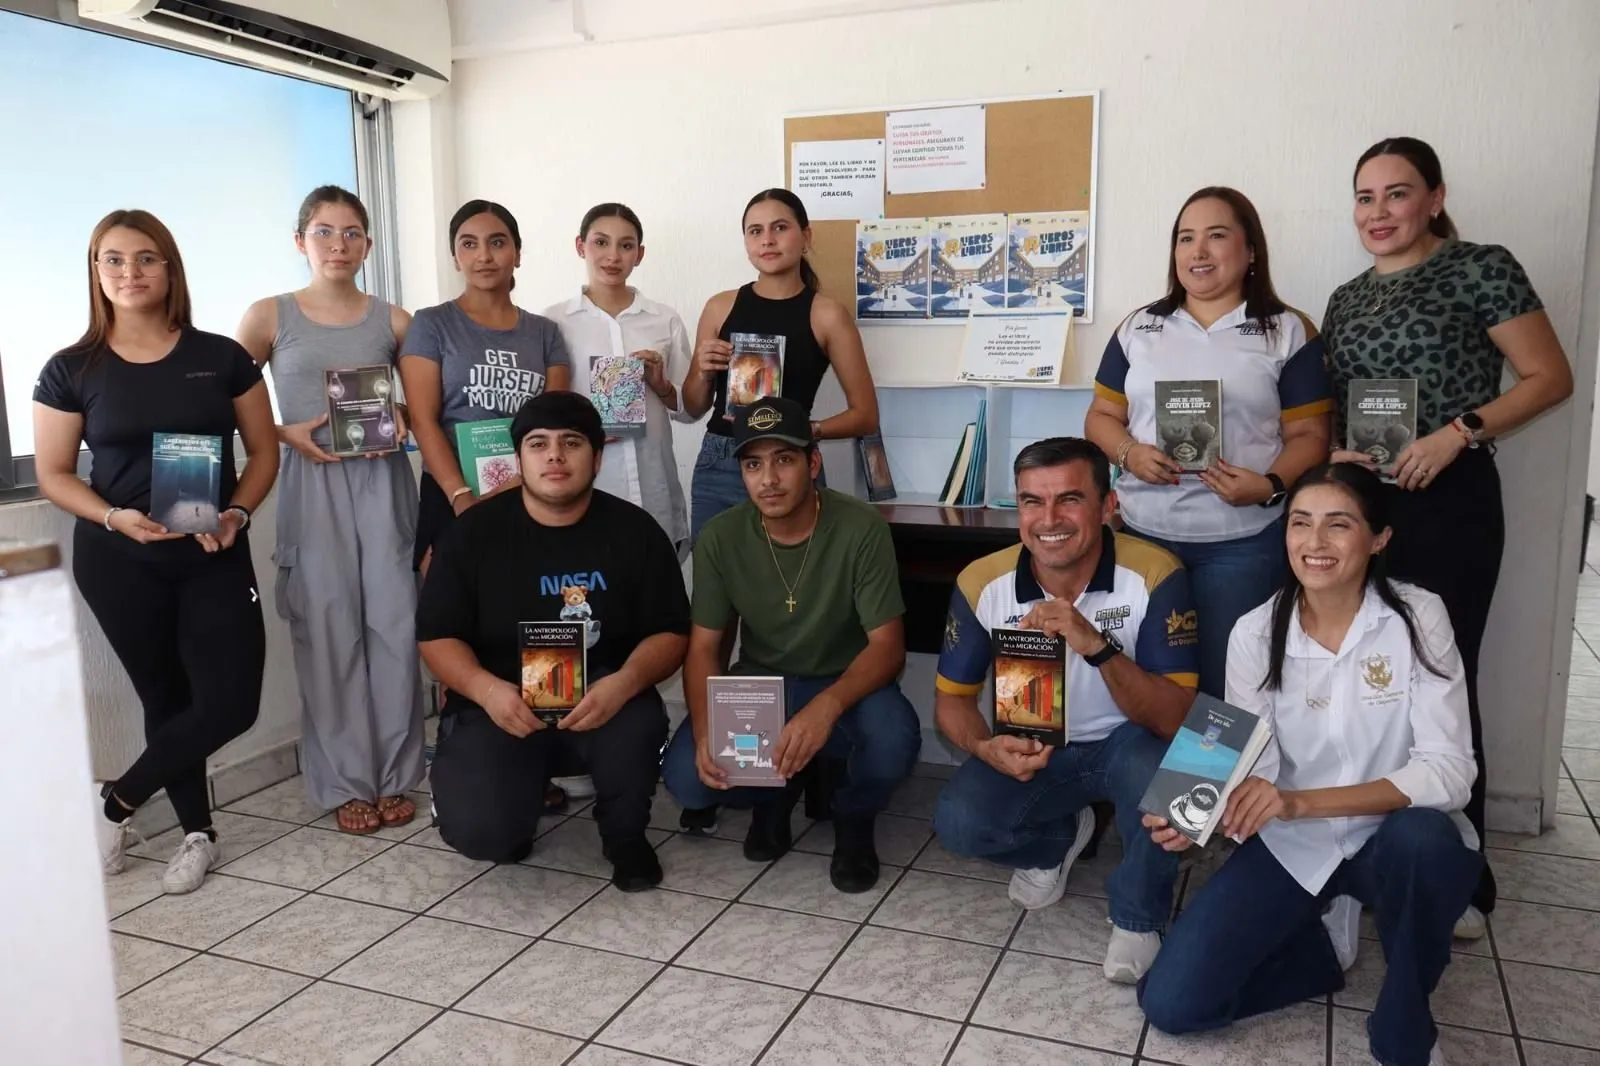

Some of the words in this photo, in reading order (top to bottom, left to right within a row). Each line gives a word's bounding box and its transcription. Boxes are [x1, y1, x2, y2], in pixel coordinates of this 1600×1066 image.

[885, 236, 917, 249] LIBROS
[960, 233, 993, 246] LIBROS
[1040, 230, 1074, 243] LIBROS
[886, 247, 916, 259] LIBRES
[961, 244, 992, 257] LIBRES
[1040, 241, 1073, 254] LIBRES
[485, 349, 518, 368] GET
[540, 571, 607, 596] NASA
[1005, 614, 1024, 624] JAC
[1100, 618, 1124, 630] UAS
[1008, 635, 1059, 644] ANTROPOLOGÍA
